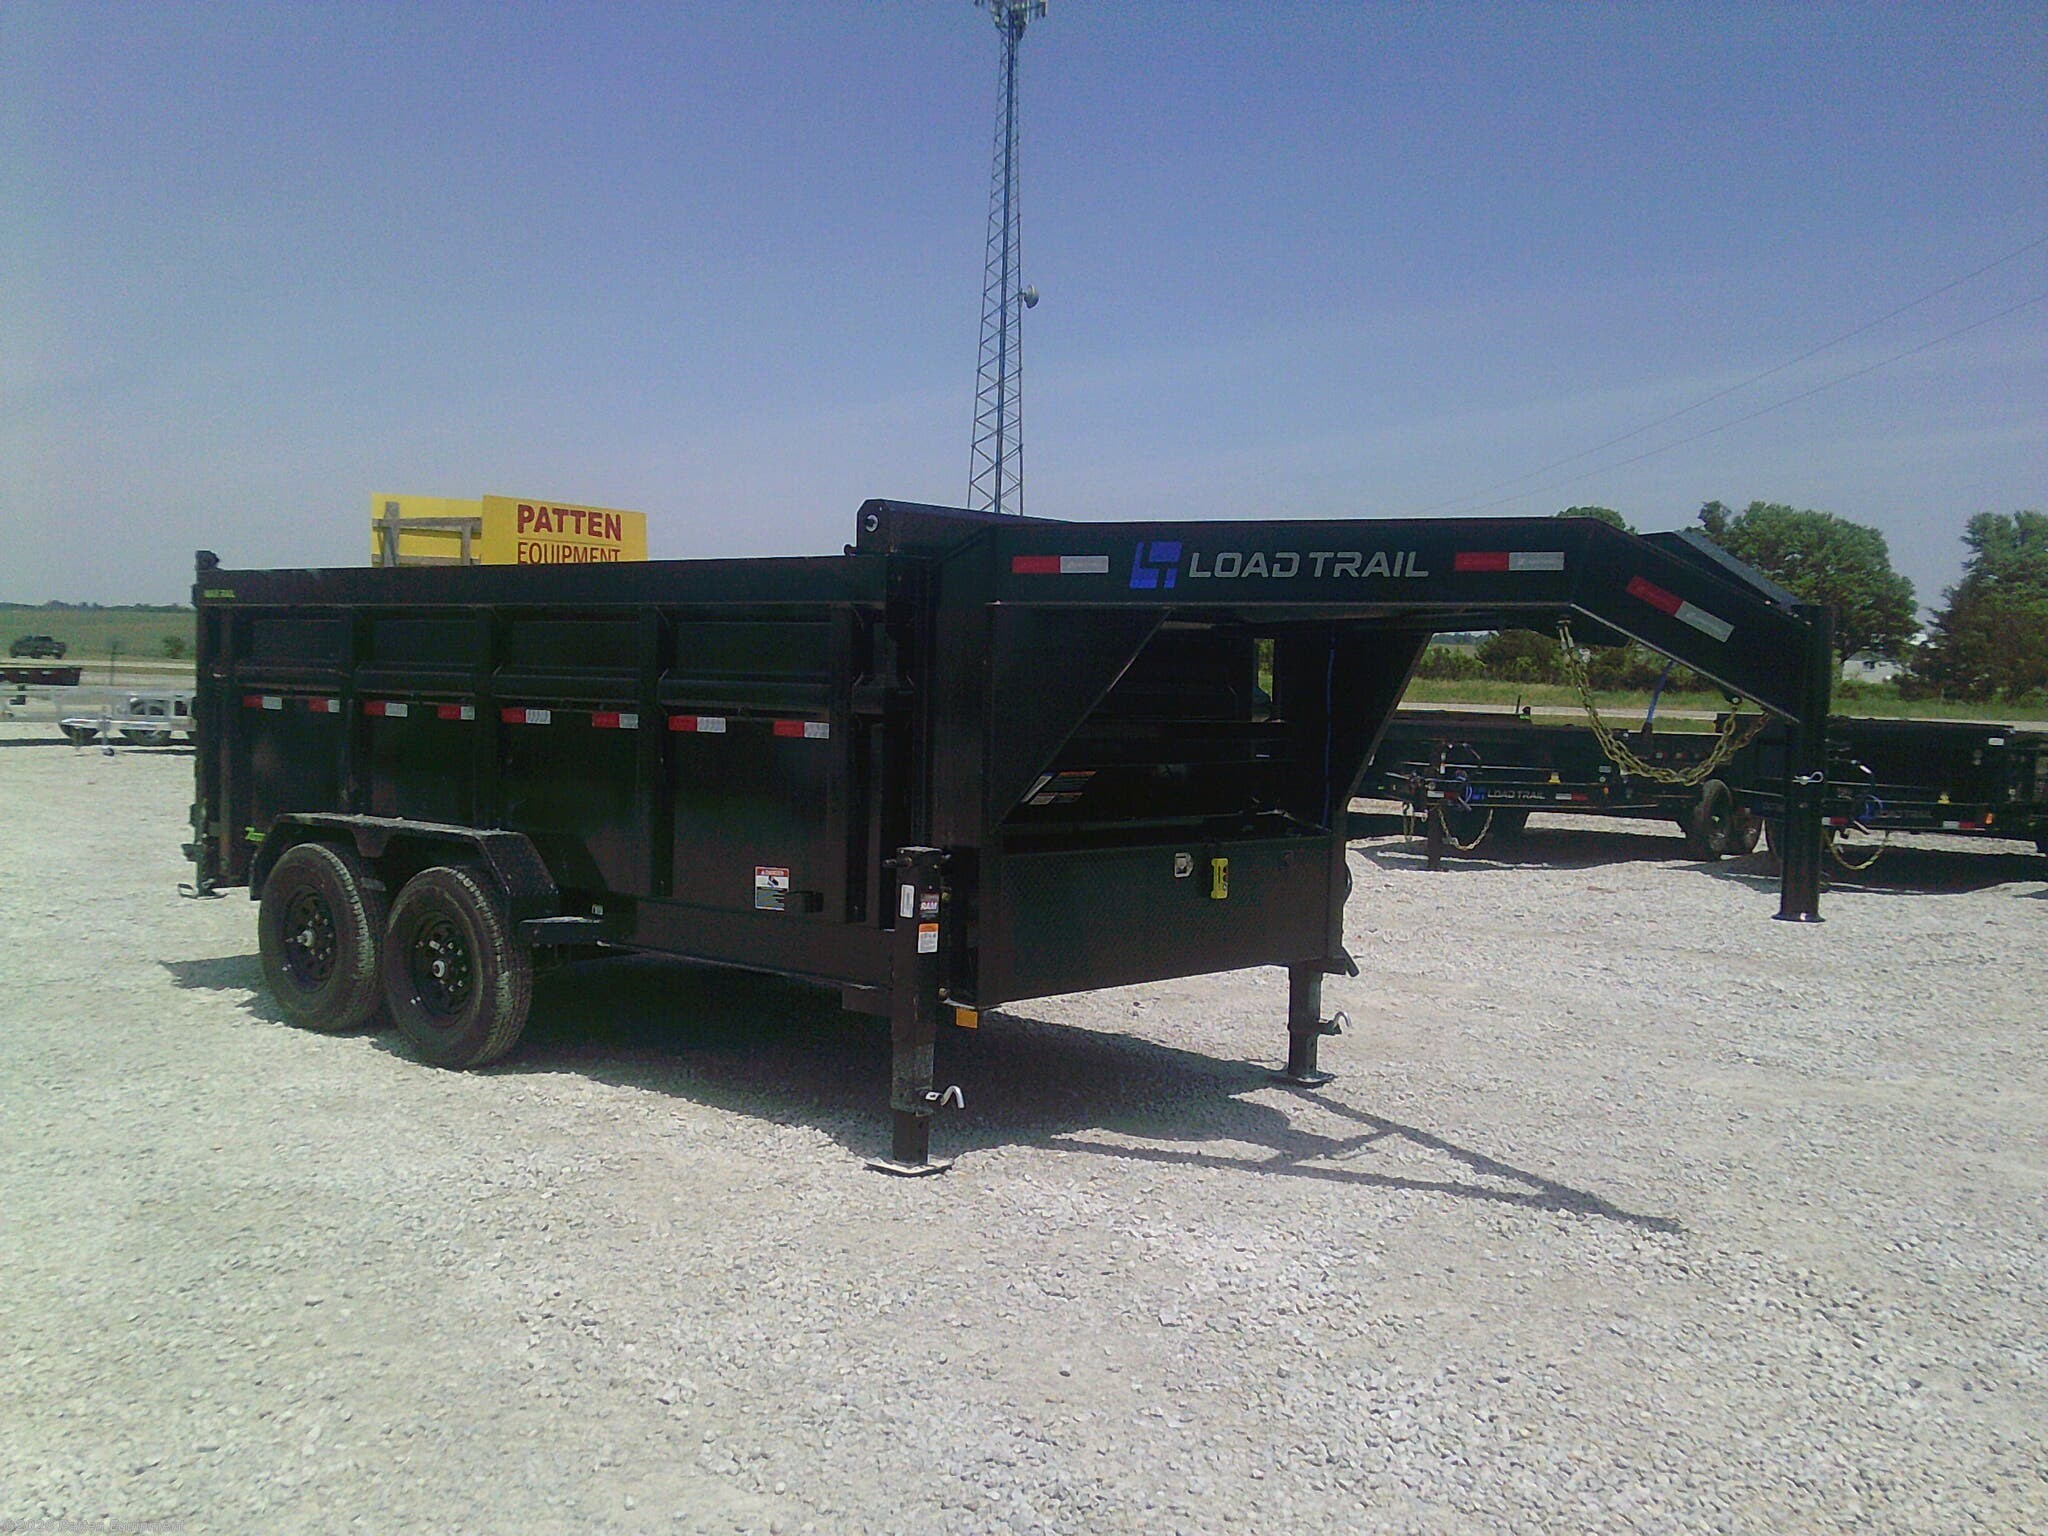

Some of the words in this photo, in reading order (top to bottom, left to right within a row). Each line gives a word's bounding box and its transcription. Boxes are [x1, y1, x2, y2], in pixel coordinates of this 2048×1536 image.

[517, 504, 622, 541] PATTEN
[517, 541, 621, 565] EQUIPMENT
[1188, 552, 1301, 579] LOAD
[1307, 551, 1430, 579] TRAIL
[1487, 789, 1515, 799] LOAD
[1517, 790, 1546, 800] TRAIL
